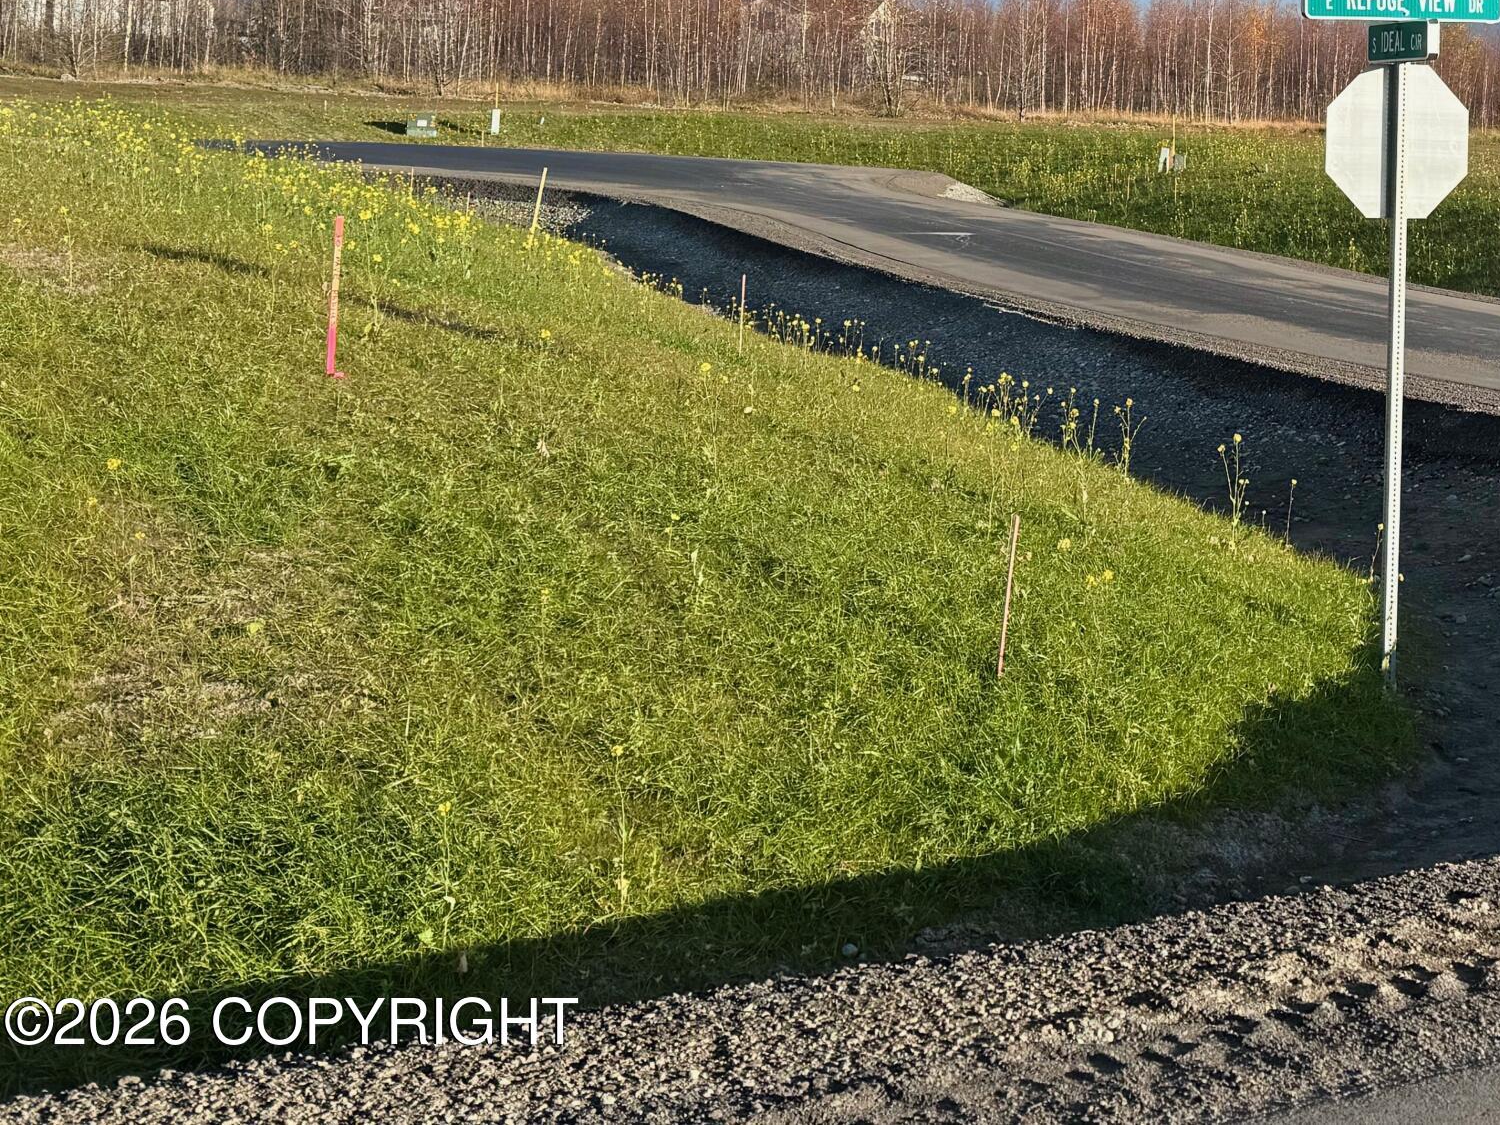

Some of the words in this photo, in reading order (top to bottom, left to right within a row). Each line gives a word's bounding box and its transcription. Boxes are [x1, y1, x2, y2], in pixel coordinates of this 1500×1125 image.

[1372, 38, 1377, 53] S
[1380, 30, 1405, 53] IDEAL
[1410, 33, 1422, 51] CIR
